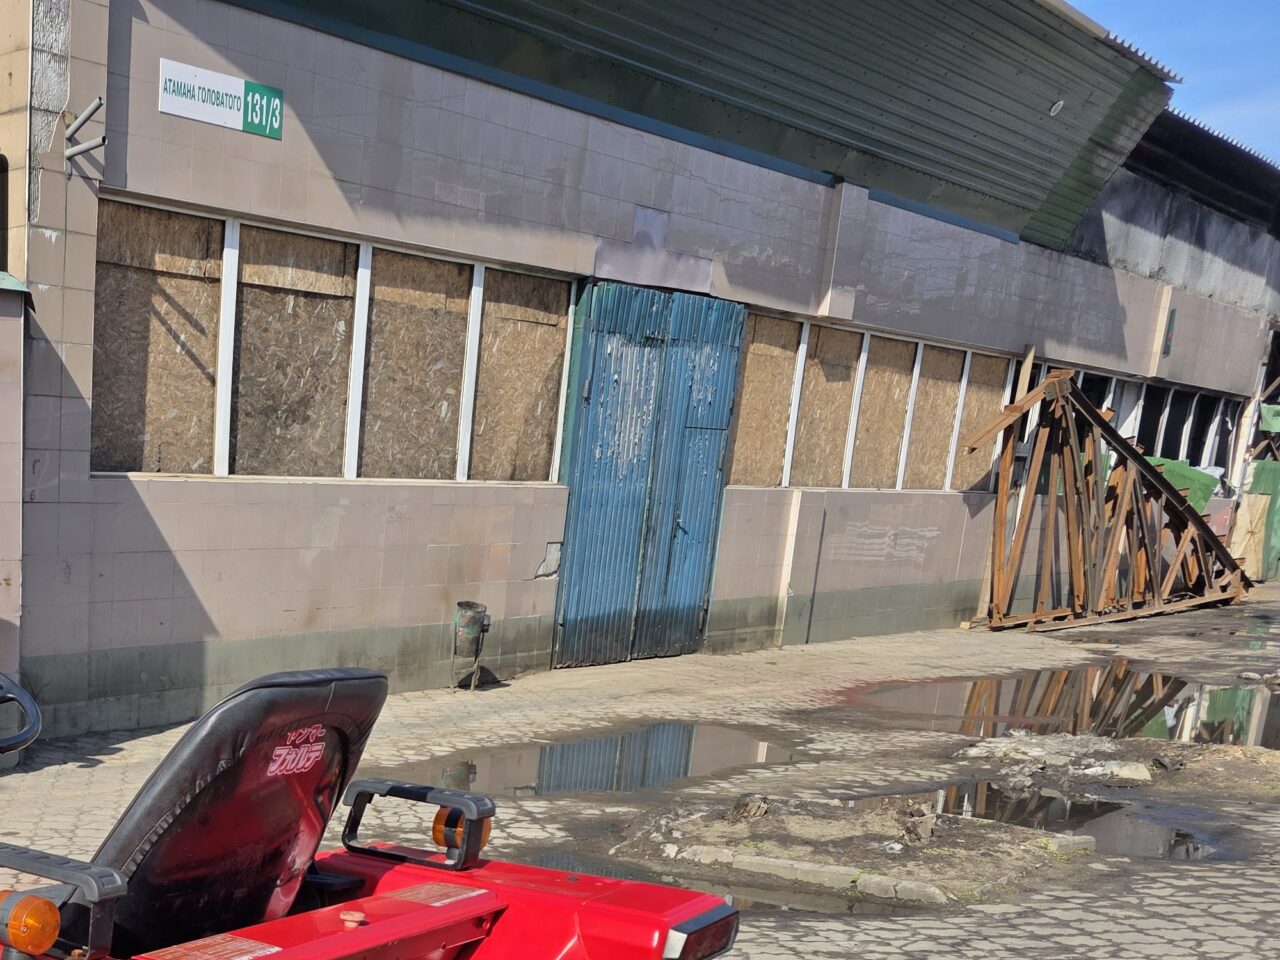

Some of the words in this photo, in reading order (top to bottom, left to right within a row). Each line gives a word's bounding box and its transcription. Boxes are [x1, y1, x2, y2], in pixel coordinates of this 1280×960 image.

[163, 77, 196, 101] АТАМАНА
[197, 86, 241, 112] ГОЛОВАТОГО
[247, 91, 280, 134] 131/3
[287, 724, 326, 744] ヤンマー
[267, 742, 325, 776] フォルテ
